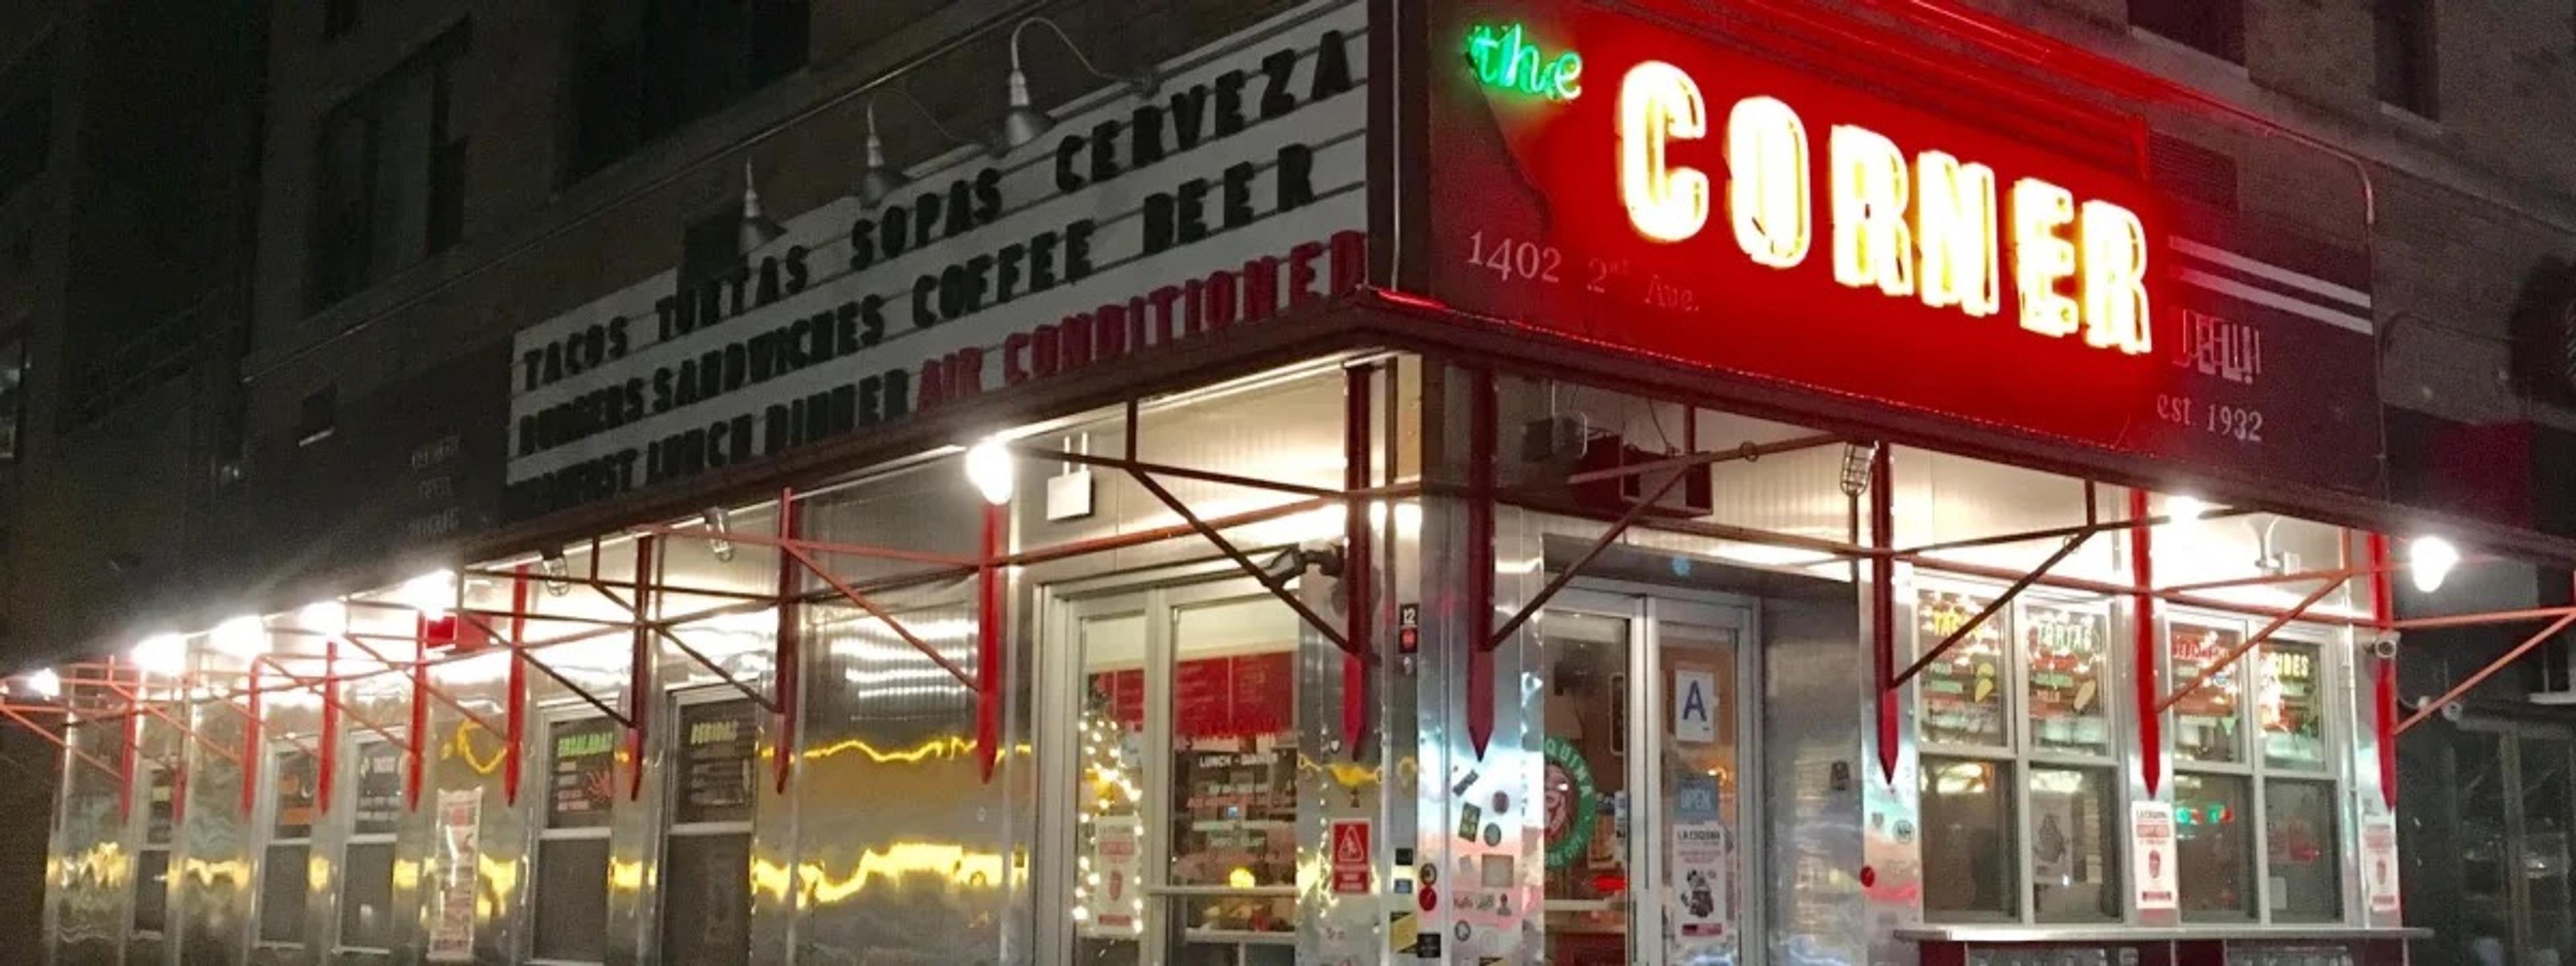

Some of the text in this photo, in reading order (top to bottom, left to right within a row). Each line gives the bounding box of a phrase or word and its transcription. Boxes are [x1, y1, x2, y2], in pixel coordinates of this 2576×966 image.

[1470, 23, 1582, 101] the
[525, 316, 629, 391] TACOS
[851, 168, 1002, 270] SOPAS
[1056, 31, 1351, 193] CERVEZA
[653, 294, 885, 412] SANDWICHES
[913, 219, 1094, 328] COFFEE
[1142, 144, 1315, 256] BEER
[1466, 231, 1562, 282] 1402
[1619, 60, 2151, 354] CORNER
[765, 369, 909, 455] DINNER
[916, 347, 982, 413] AIR
[1004, 230, 1366, 386] CONDITIONED
[2206, 404, 2263, 441] 1932
[1682, 680, 1707, 722] A
